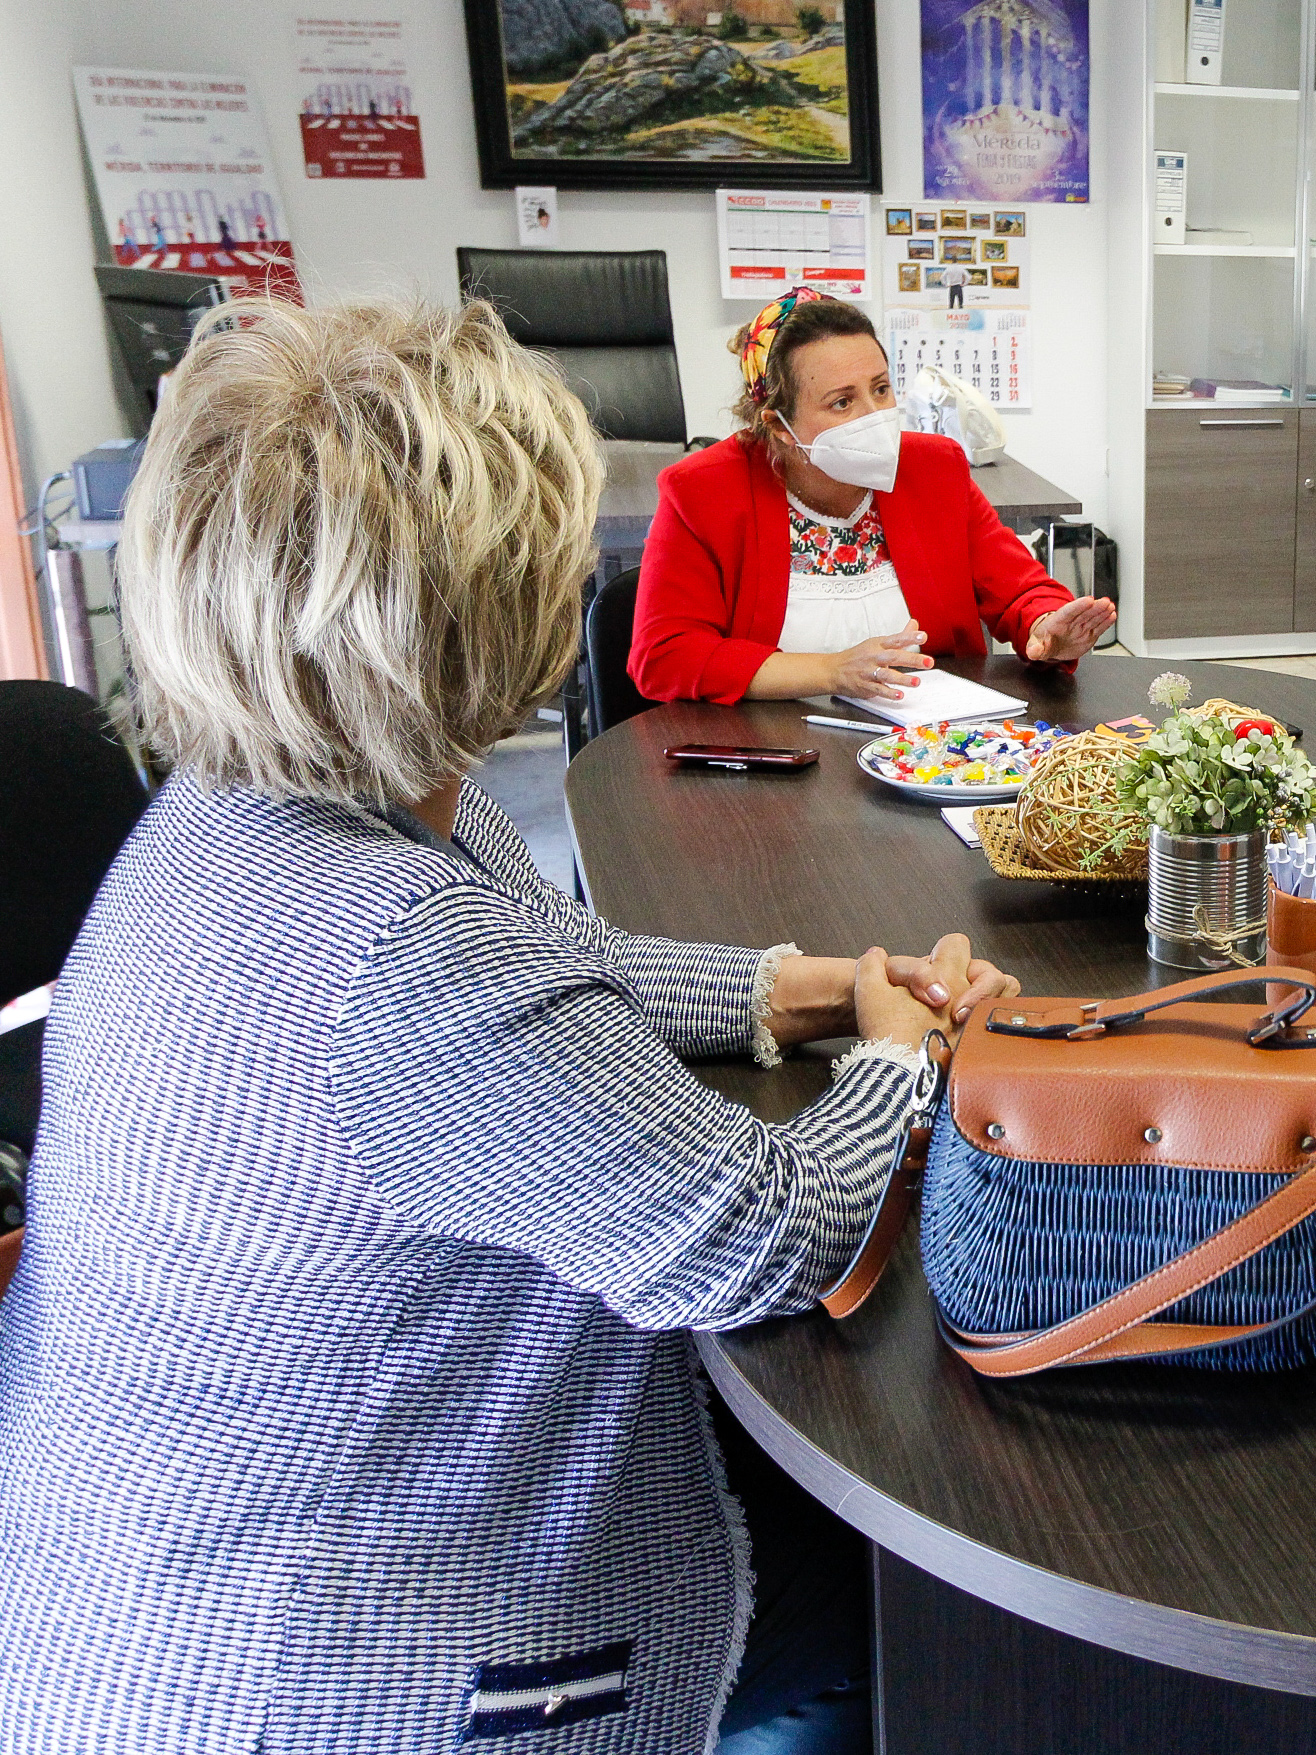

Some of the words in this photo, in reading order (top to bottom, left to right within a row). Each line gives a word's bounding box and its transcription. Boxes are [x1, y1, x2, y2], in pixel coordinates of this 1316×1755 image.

[973, 350, 979, 361] 7
[897, 363, 906, 374] 10
[953, 363, 962, 374] 13
[972, 363, 981, 375] 14
[990, 363, 999, 375] 15
[1009, 363, 1018, 375] 16
[897, 377, 905, 388] 17
[990, 377, 1000, 388] 22
[1009, 377, 1018, 388] 23
[990, 390, 1000, 401] 29
